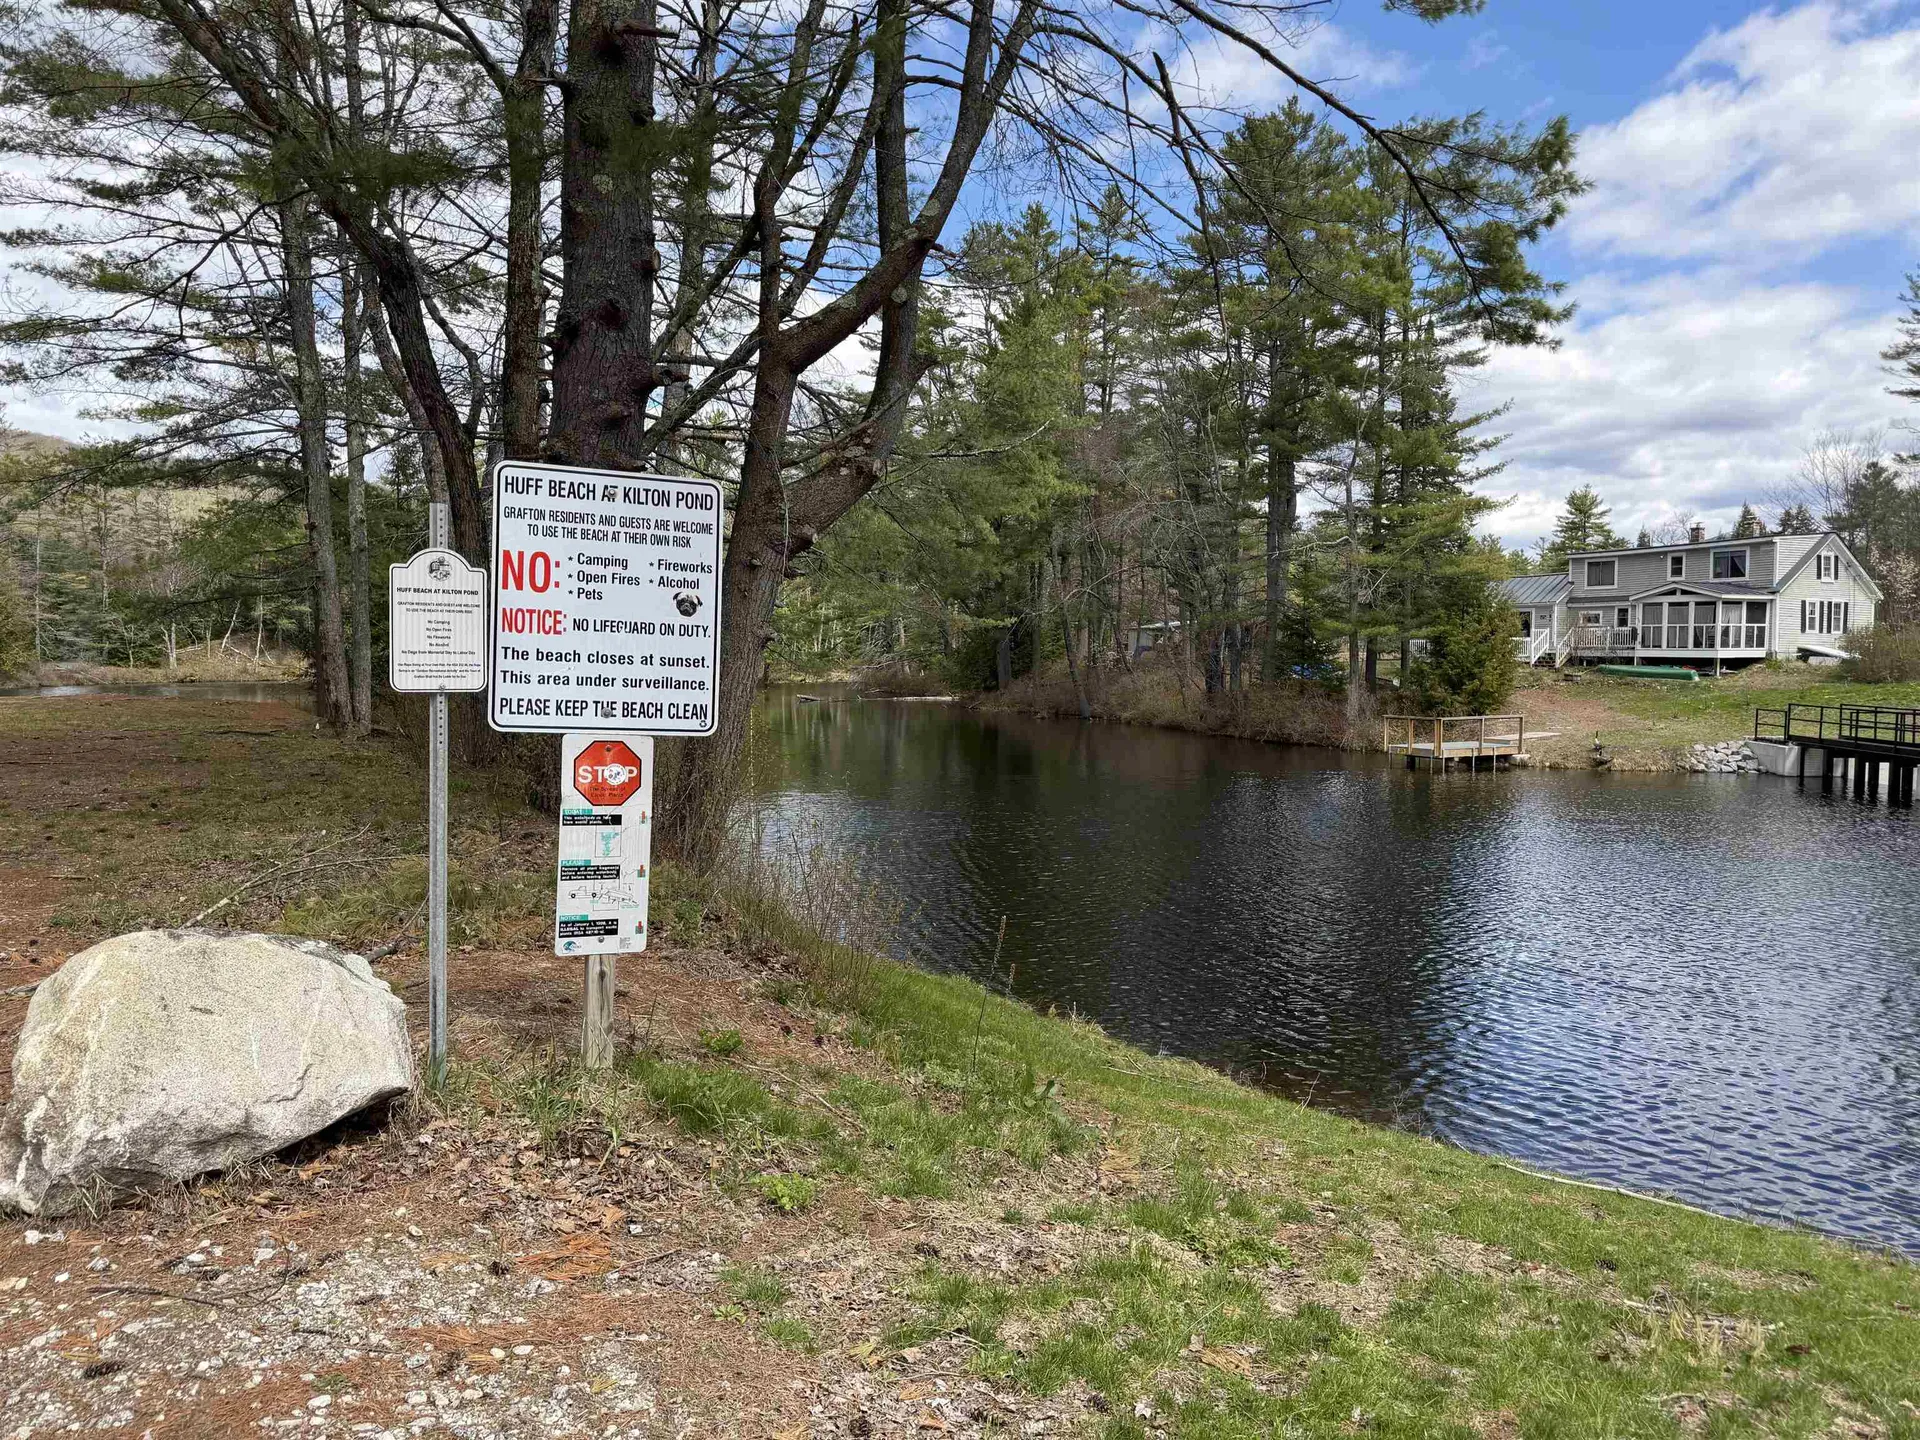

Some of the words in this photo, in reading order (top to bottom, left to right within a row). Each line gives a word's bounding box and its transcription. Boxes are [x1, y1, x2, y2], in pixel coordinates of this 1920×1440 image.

[504, 476, 543, 496] HUFF
[550, 479, 596, 501] BEACH
[601, 484, 618, 502] AT
[623, 486, 671, 508] KILTON
[676, 492, 714, 511] POND
[504, 506, 546, 521] GRAFTON
[550, 510, 596, 525] RESIDENTS
[598, 514, 616, 527] AND
[619, 516, 651, 530] GUESTS
[654, 519, 670, 532] ARE
[673, 520, 714, 535] WELCOME
[528, 524, 538, 536] TO
[542, 525, 558, 538] USE
[562, 527, 578, 540] THE
[580, 528, 608, 542] BEACH
[611, 530, 622, 543] AT
[624, 532, 647, 545] THEIR
[650, 533, 670, 546] OWN
[673, 535, 692, 548] RISK
[577, 552, 628, 570] Camping
[658, 560, 712, 574] Fireworks
[502, 550, 560, 594] NO:
[577, 570, 607, 586] Open
[612, 573, 640, 586] Fires
[658, 576, 700, 590] Alcohol
[577, 588, 603, 600] Pets
[502, 608, 568, 635] NOTICE:
[572, 618, 588, 632] NO
[594, 619, 656, 634] LIFEGUARD
[660, 623, 674, 636] ON
[679, 624, 710, 638] DUTY.
[502, 646, 529, 661] The
[536, 649, 581, 662] beach
[587, 652, 634, 665] closes
[640, 654, 654, 666] at
[660, 656, 710, 668] sunset.
[500, 670, 531, 684] This
[537, 674, 570, 686] area
[576, 674, 616, 688] under
[622, 676, 710, 691] surveillance.
[500, 698, 550, 716] PLEASE
[555, 700, 588, 716] KEEP
[622, 702, 663, 719] BEACH
[668, 702, 708, 720] CLEAN
